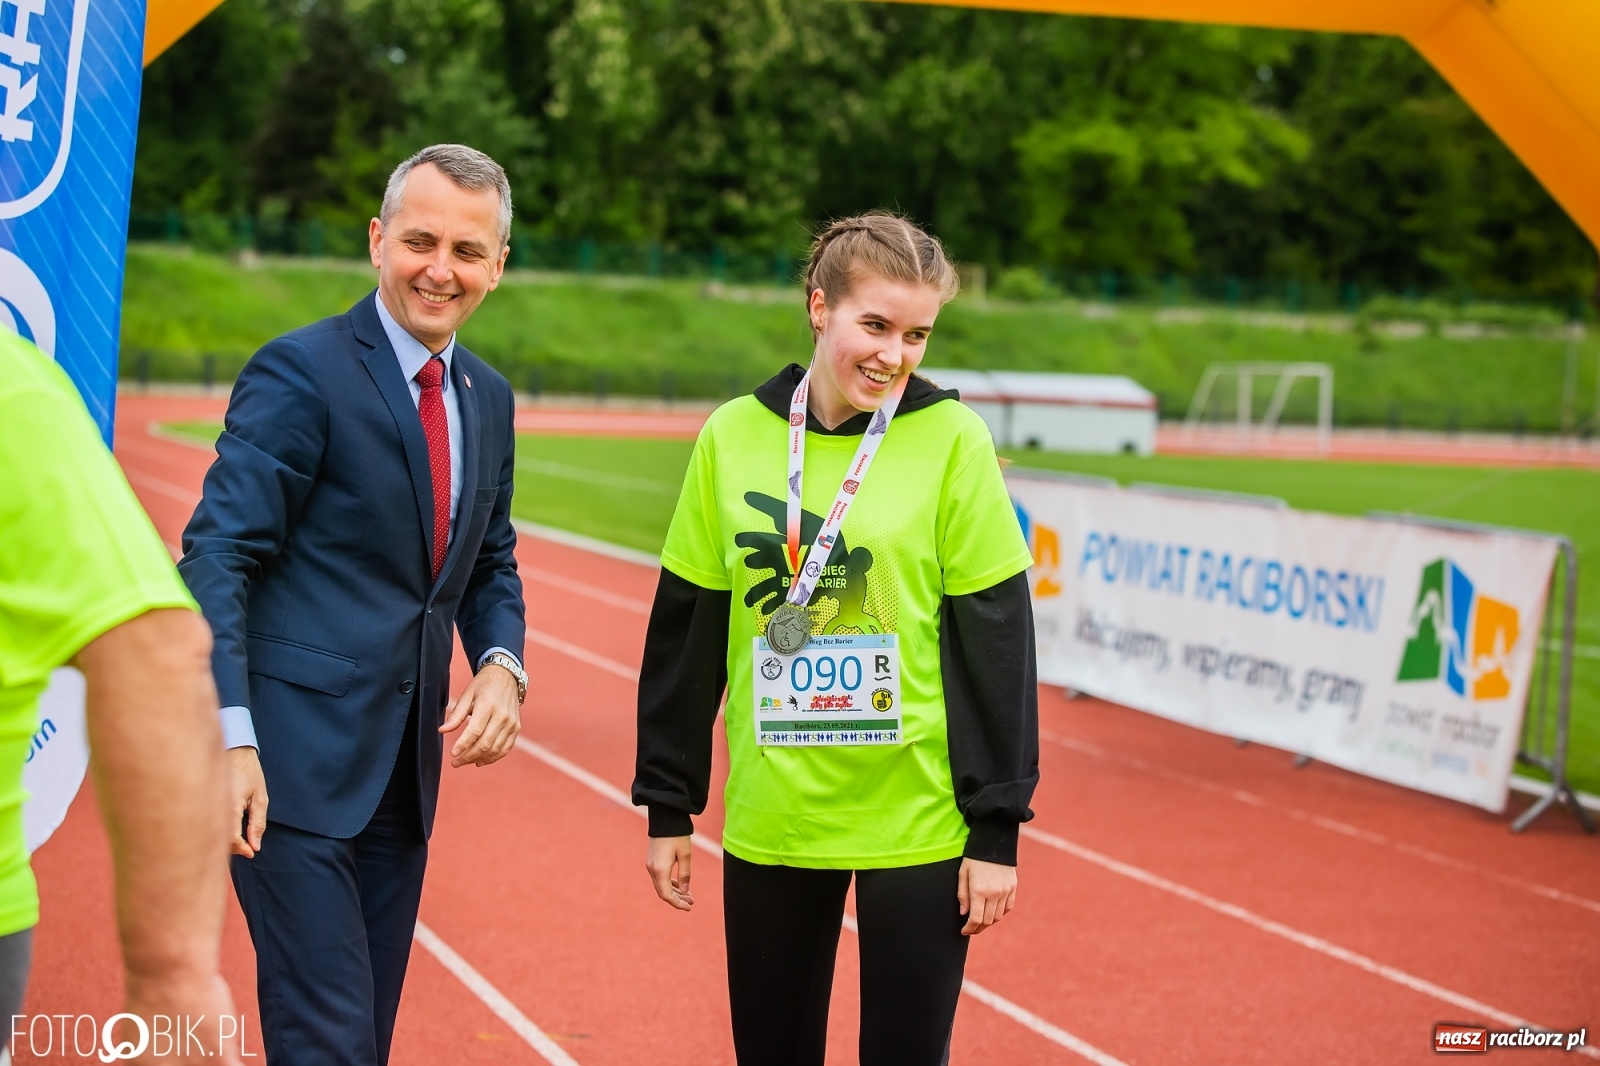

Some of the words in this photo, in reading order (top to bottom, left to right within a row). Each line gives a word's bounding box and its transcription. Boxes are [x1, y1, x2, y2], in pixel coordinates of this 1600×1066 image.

[821, 565, 846, 576] BIEG
[815, 577, 847, 589] ARIER
[1078, 531, 1191, 597] POWIAT
[1194, 549, 1387, 634] RACIBORSKI
[874, 655, 891, 673] R
[790, 656, 862, 692] 090
[823, 722, 854, 730] 23.05.2021
